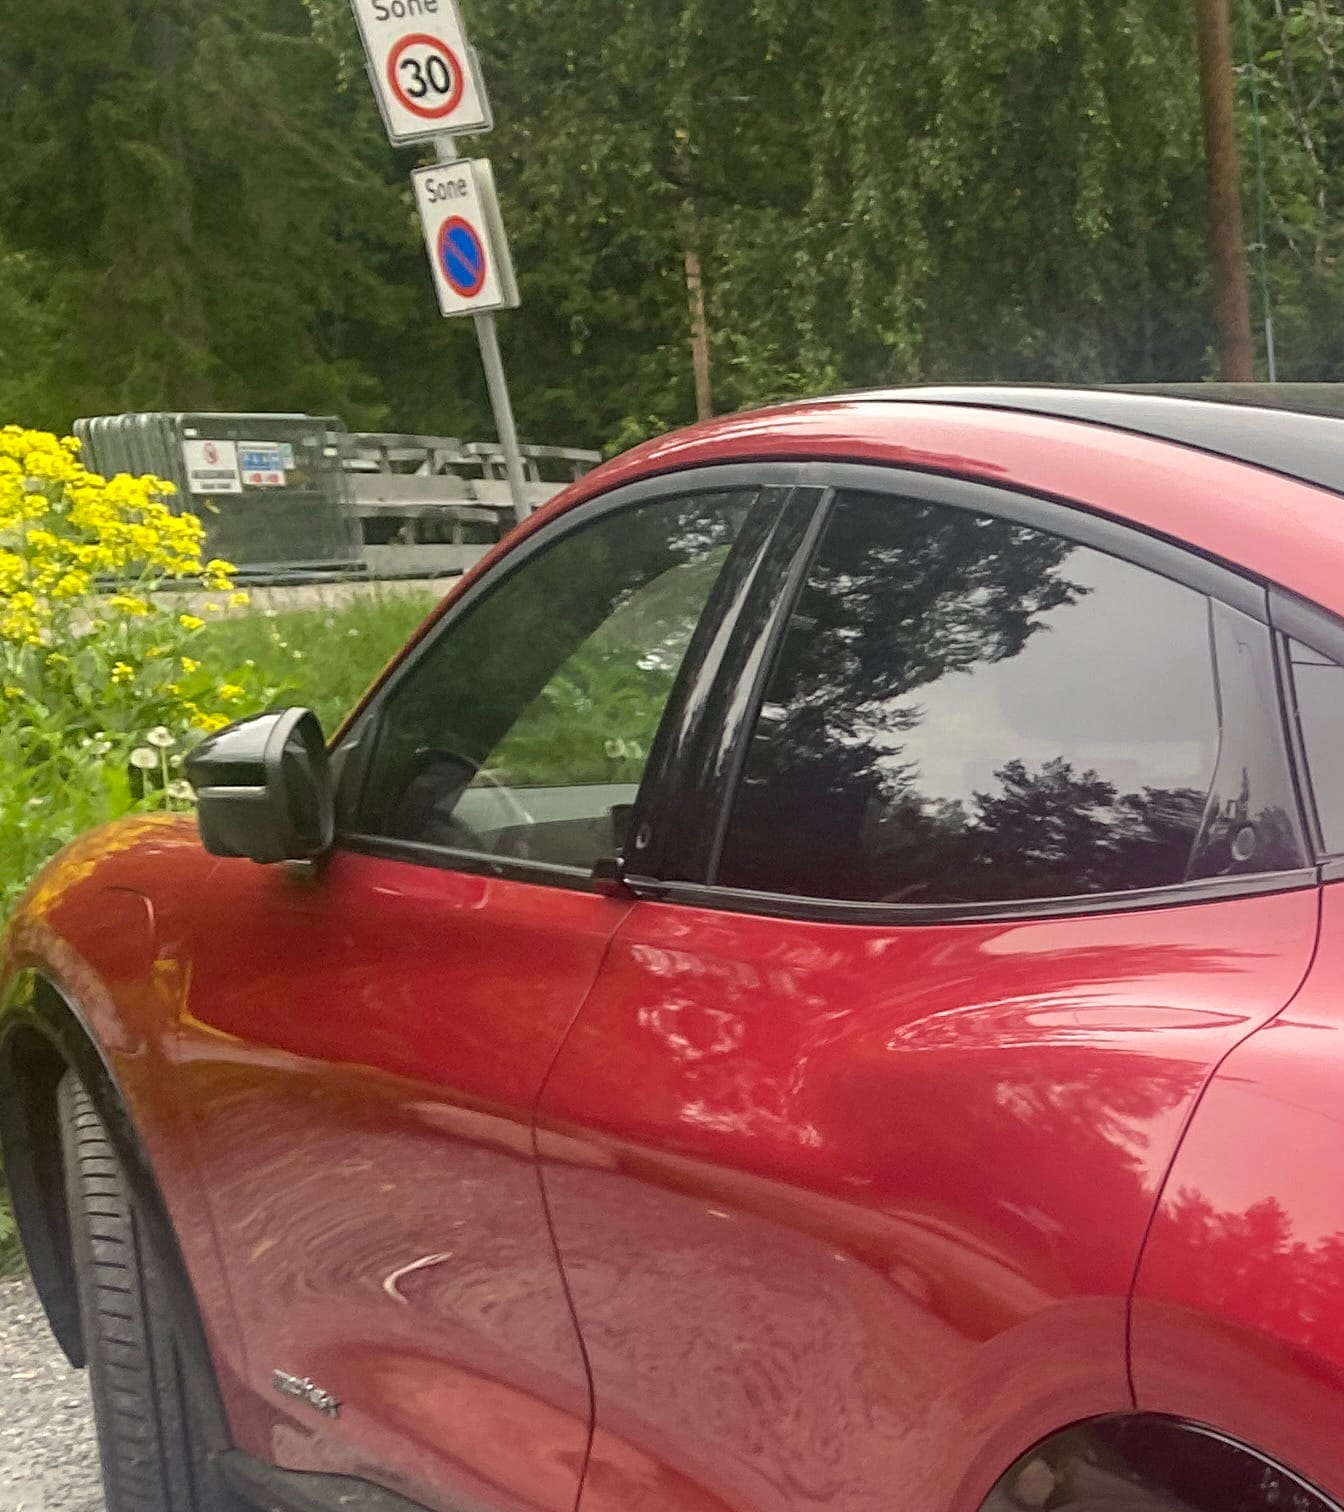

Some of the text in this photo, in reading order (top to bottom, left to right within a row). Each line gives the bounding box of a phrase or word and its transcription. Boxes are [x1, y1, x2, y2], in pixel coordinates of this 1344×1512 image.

[371, 0, 438, 21] Sone
[400, 55, 450, 98] 30
[425, 178, 467, 203] Sone
